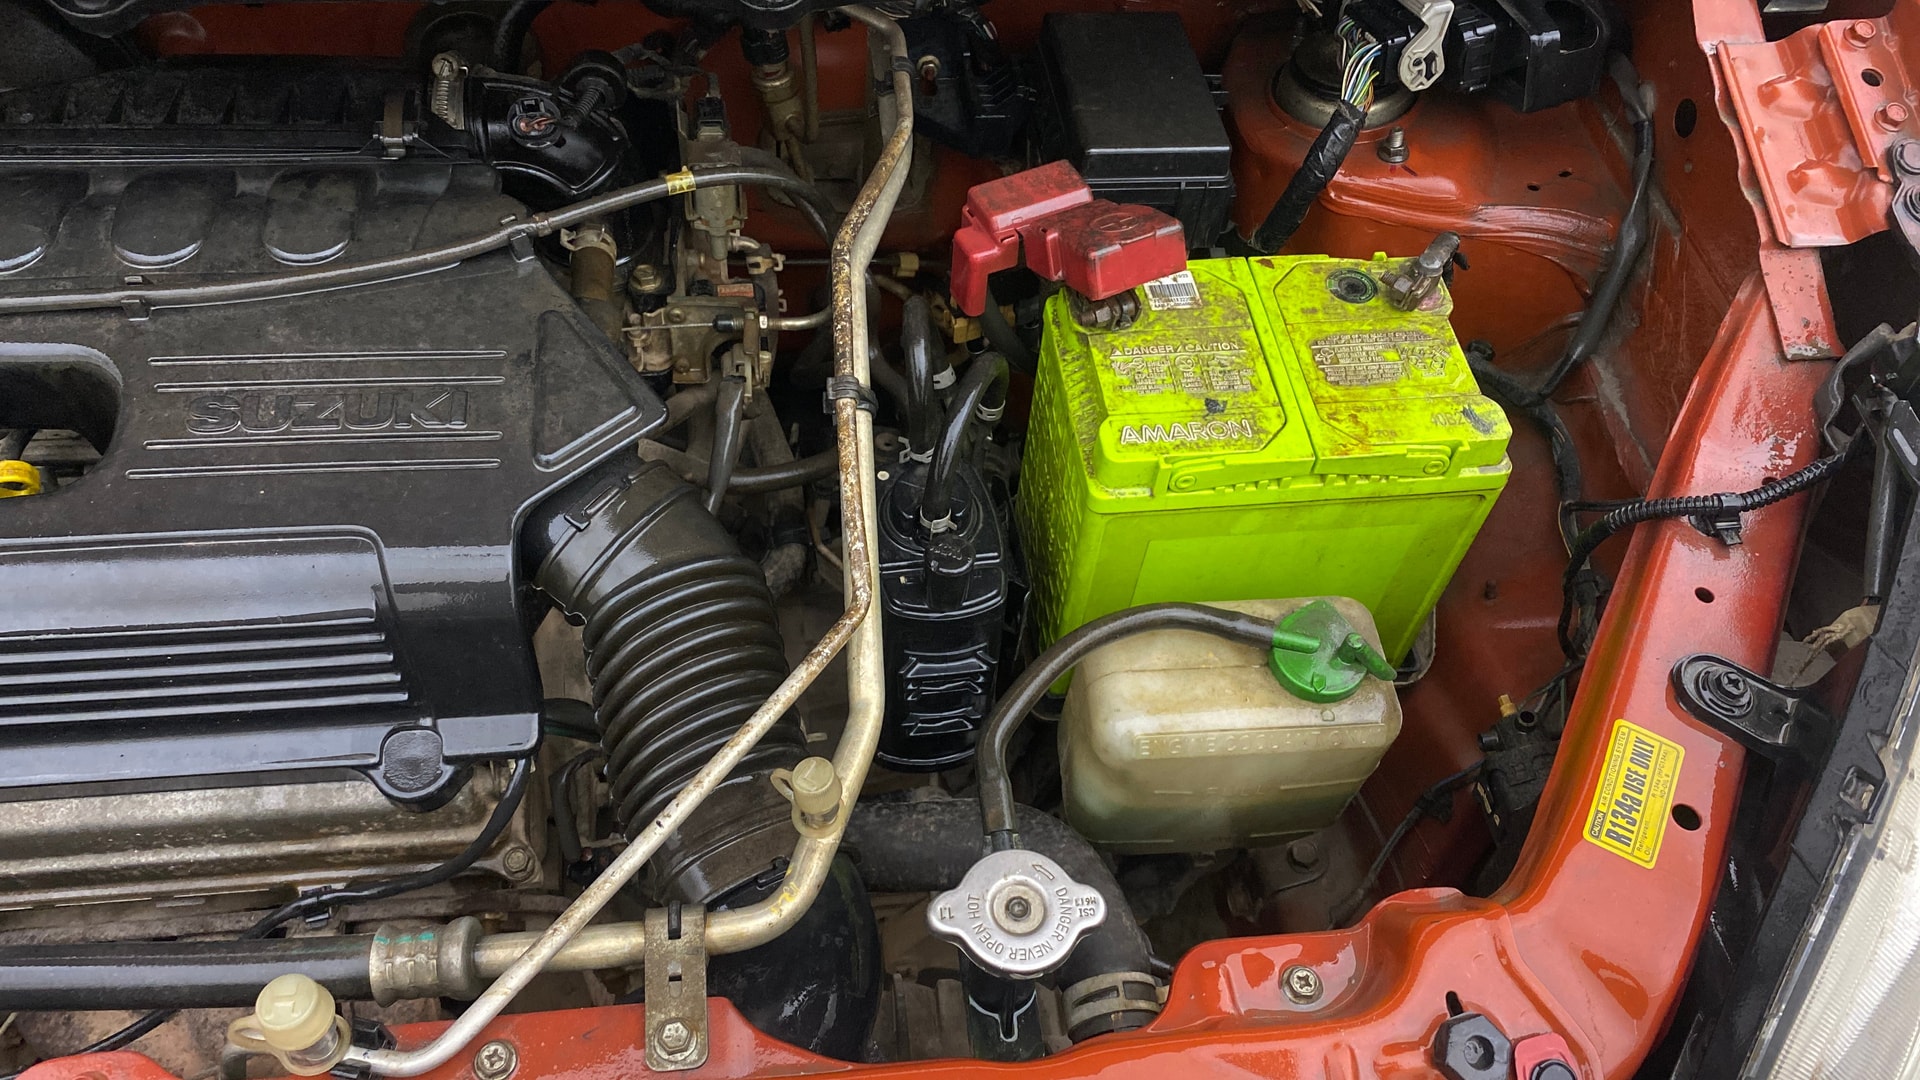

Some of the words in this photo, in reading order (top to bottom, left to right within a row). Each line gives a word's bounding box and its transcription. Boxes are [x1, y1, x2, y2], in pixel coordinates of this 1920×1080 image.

[1124, 345, 1174, 355] DANGER
[1185, 342, 1239, 352] CAUTION
[185, 389, 469, 435] SUZUKI
[1120, 418, 1253, 445] AMARON
[1616, 731, 1627, 755] SYSTEM
[1629, 736, 1655, 771] ONLY
[795, 759, 818, 791] L
[1603, 754, 1619, 796] CONDITIONING
[1622, 767, 1648, 796] USE
[1600, 796, 1608, 807] AIR
[1591, 812, 1605, 837] CAUTION
[1605, 792, 1643, 848] R134a
[939, 906, 955, 921] 1.1
[967, 893, 981, 921] HOT
[1051, 886, 1072, 943] DANGER
[1078, 907, 1096, 918] CSI
[972, 923, 1005, 955] OPEN
[1009, 940, 1054, 961] NEVER
[262, 983, 302, 1021] H
